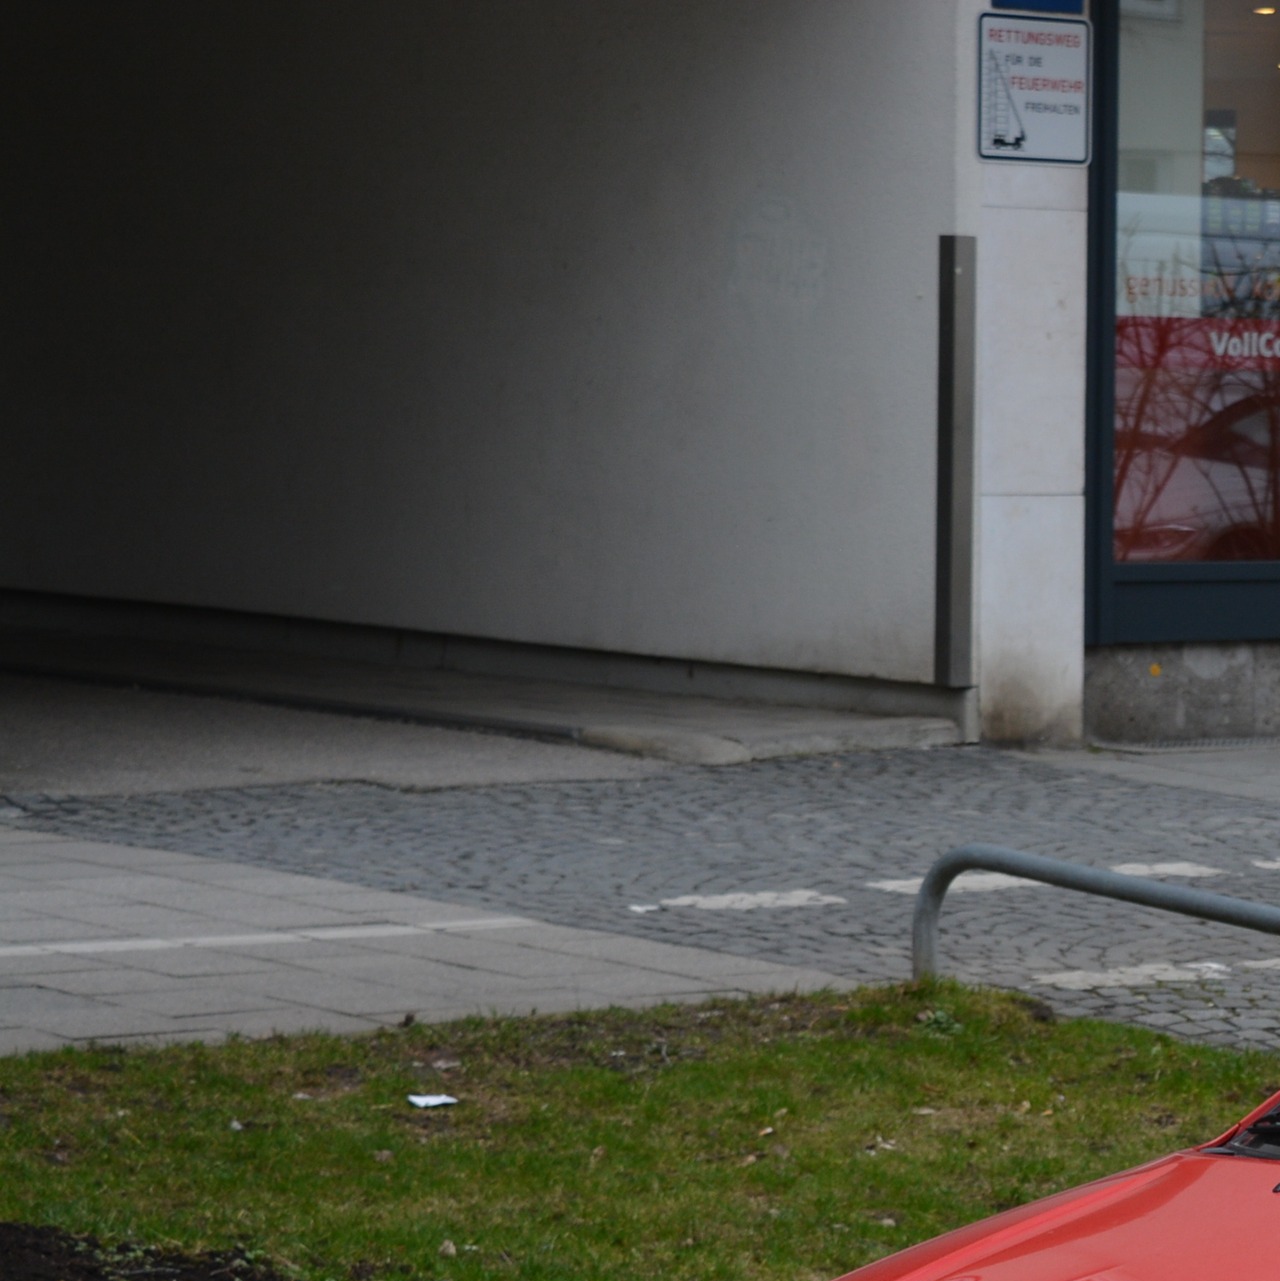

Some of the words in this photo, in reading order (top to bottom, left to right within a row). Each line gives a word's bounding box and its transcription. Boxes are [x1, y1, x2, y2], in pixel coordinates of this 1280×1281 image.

[988, 28, 1081, 48] RETTUNGSWEG
[1010, 75, 1084, 93] FEUERWEHR
[1024, 101, 1081, 115] FREIHALTEN
